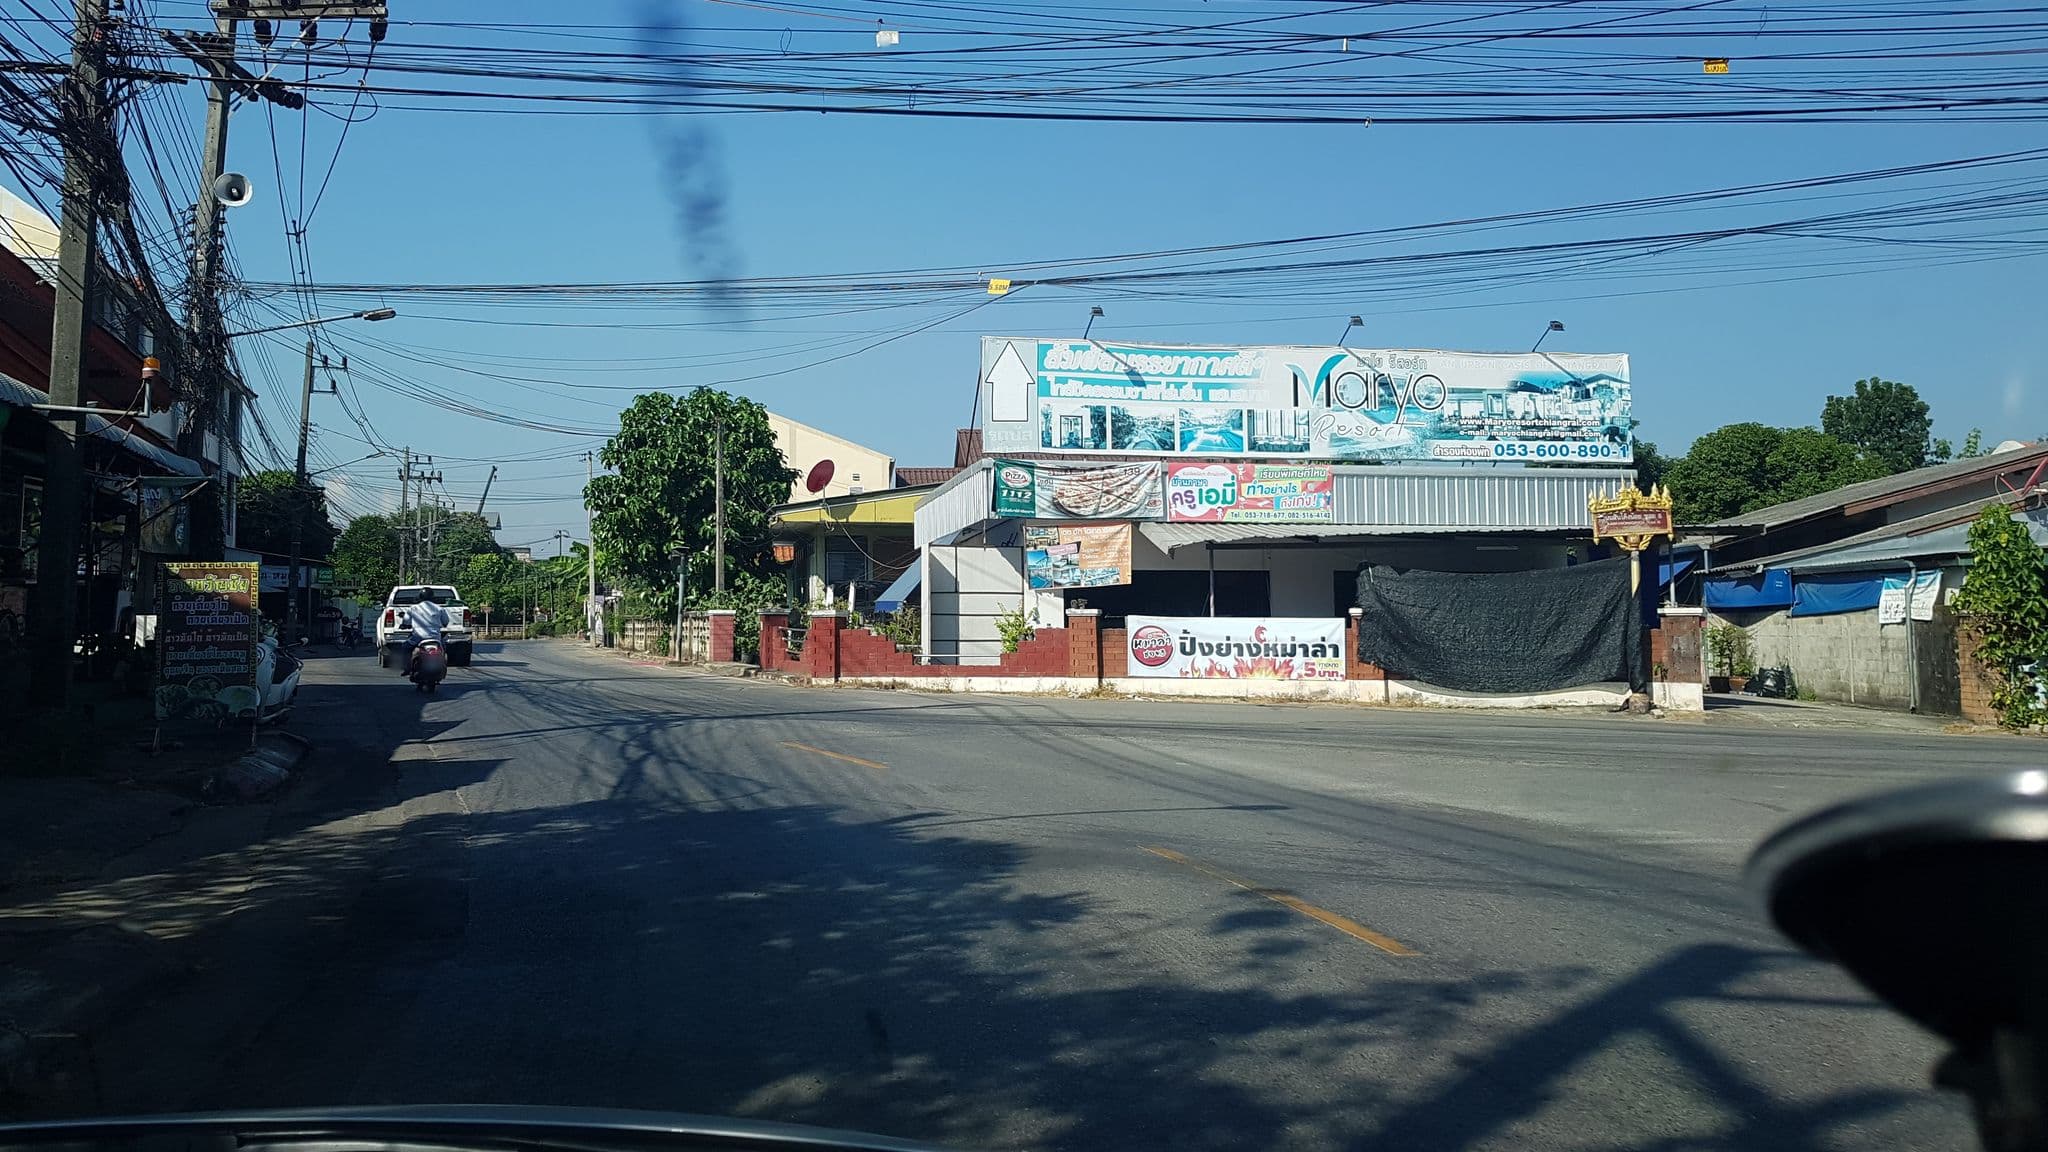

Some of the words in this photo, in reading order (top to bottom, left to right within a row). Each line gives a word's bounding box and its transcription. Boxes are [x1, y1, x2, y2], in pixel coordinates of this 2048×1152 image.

[1285, 353, 1447, 425] Maryo
[1313, 413, 1427, 441] Resort
[1494, 444, 1629, 458] 053-600-890-1
[1005, 471, 1027, 480] PIZZA
[1001, 489, 1033, 499] 1112
[1179, 629, 1340, 658] ปิ้งย่างหม่าล่า
[1303, 661, 1317, 678] 5
